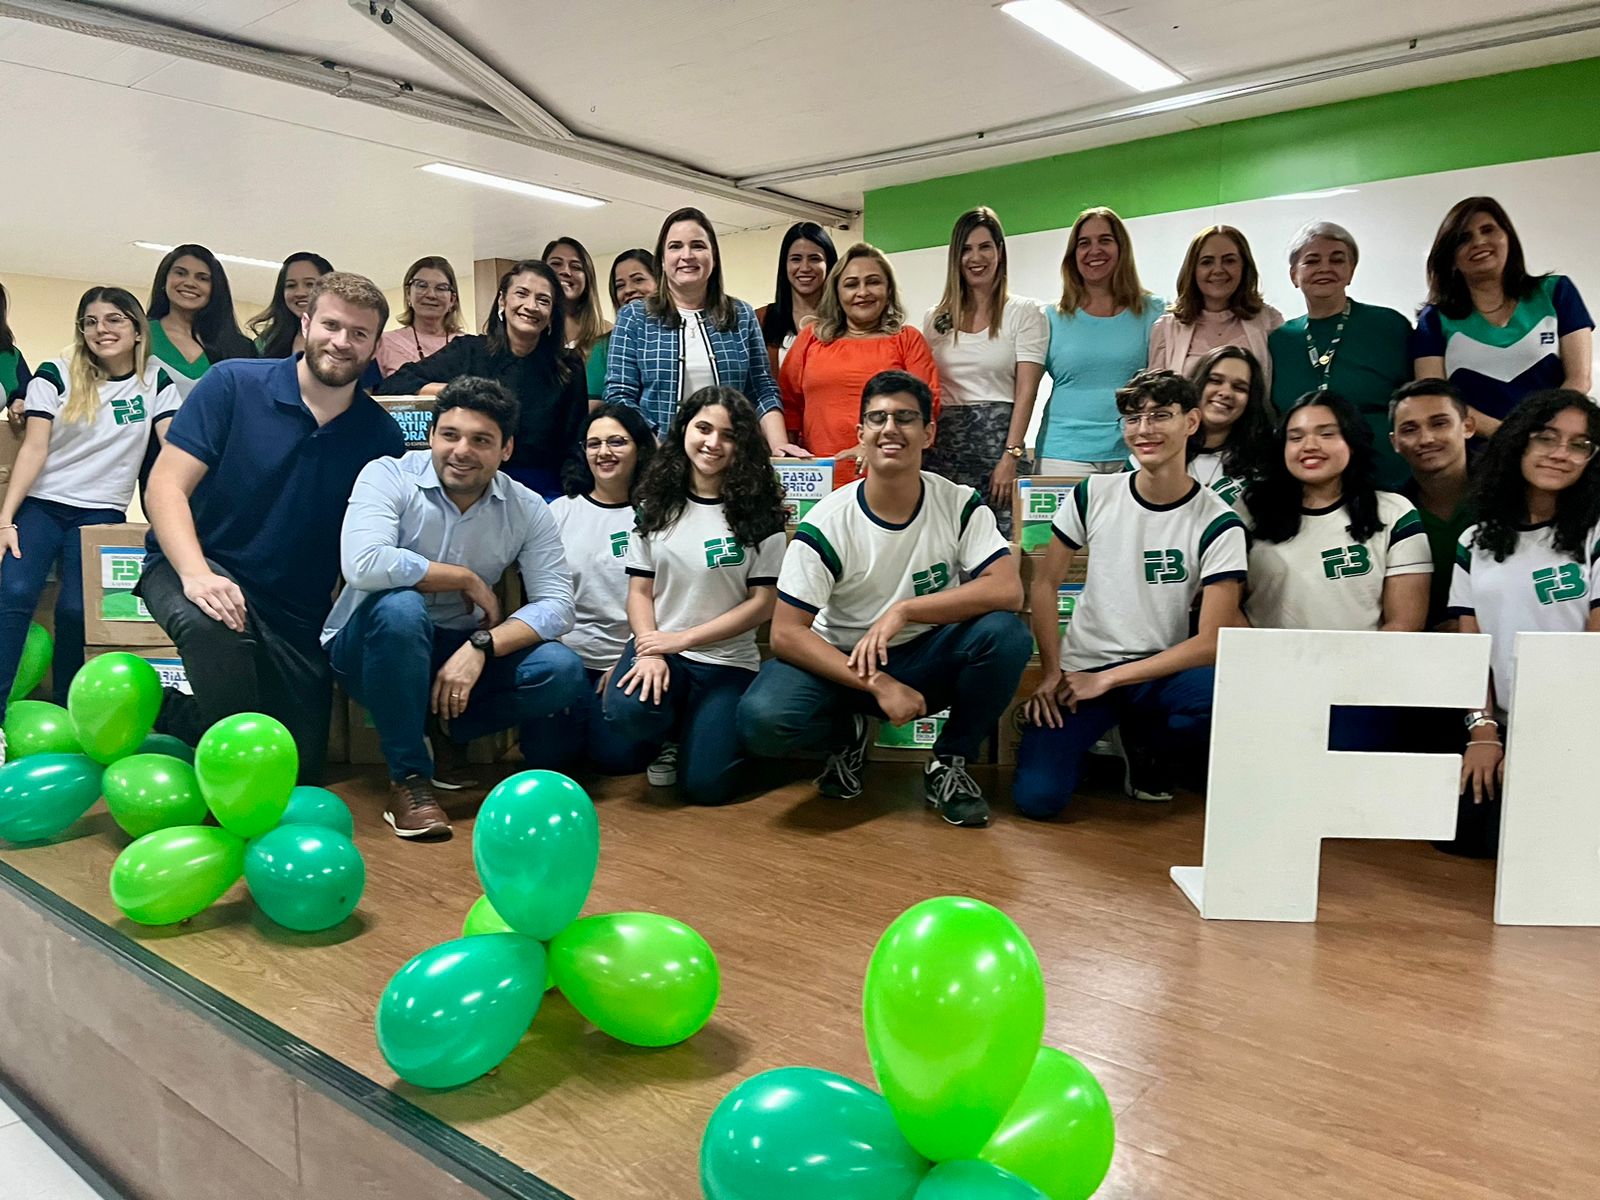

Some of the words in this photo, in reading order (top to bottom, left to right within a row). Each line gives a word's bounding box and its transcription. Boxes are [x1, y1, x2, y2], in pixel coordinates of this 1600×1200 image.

[111, 394, 147, 425] FB
[390, 411, 433, 421] PARTIR
[398, 421, 428, 431] RTIR
[1030, 493, 1057, 513] FB
[610, 530, 630, 558] F
[704, 536, 746, 569] FB
[112, 560, 139, 580] FB
[1143, 548, 1189, 585] FB
[1321, 543, 1373, 580] FB
[912, 562, 950, 597] FB
[1532, 562, 1588, 605] FB
